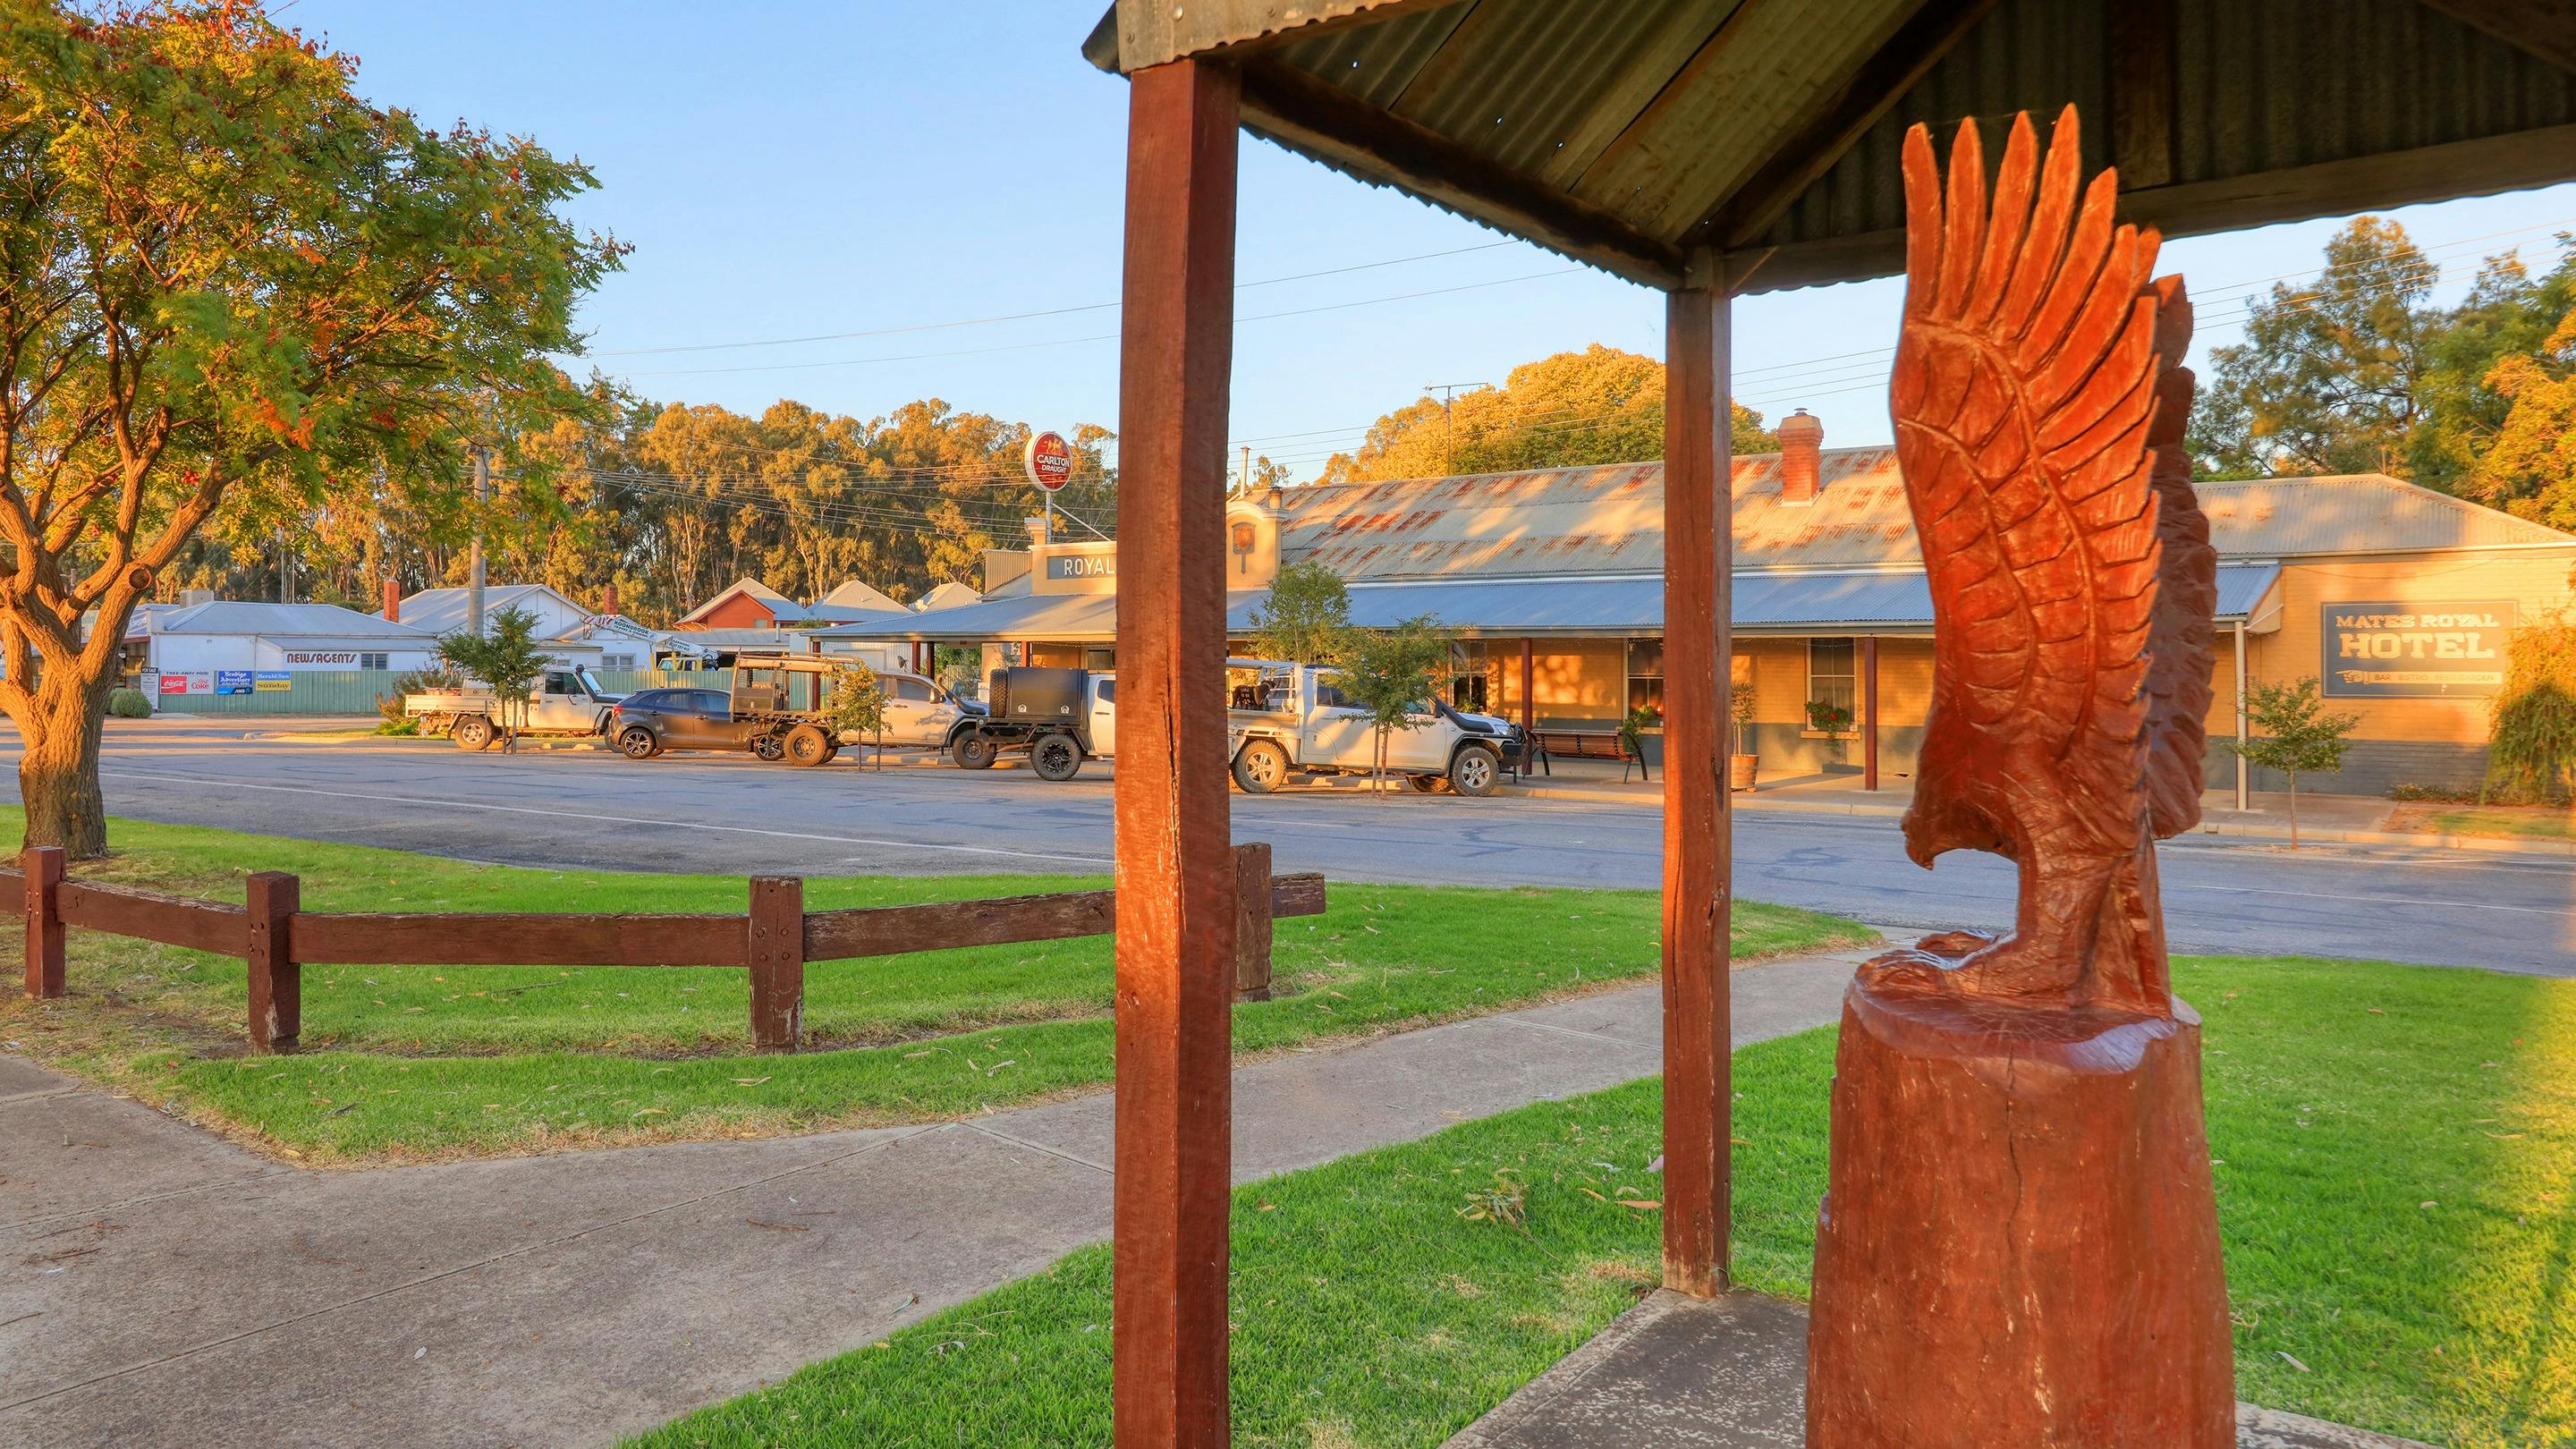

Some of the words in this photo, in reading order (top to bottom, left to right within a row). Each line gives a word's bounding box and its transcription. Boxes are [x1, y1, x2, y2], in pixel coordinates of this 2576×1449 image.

[1037, 454, 1070, 468] CARLTON
[1041, 464, 1066, 473] DRAUGHT
[1063, 557, 1115, 576] ROYAL
[614, 620, 649, 635] KOONDROOK
[2335, 614, 2415, 628] MATES
[2419, 614, 2500, 628] ROYAL
[2339, 632, 2496, 659] HOTEL
[287, 653, 357, 664] NEWSAGENTS
[191, 682, 209, 690] Coke
